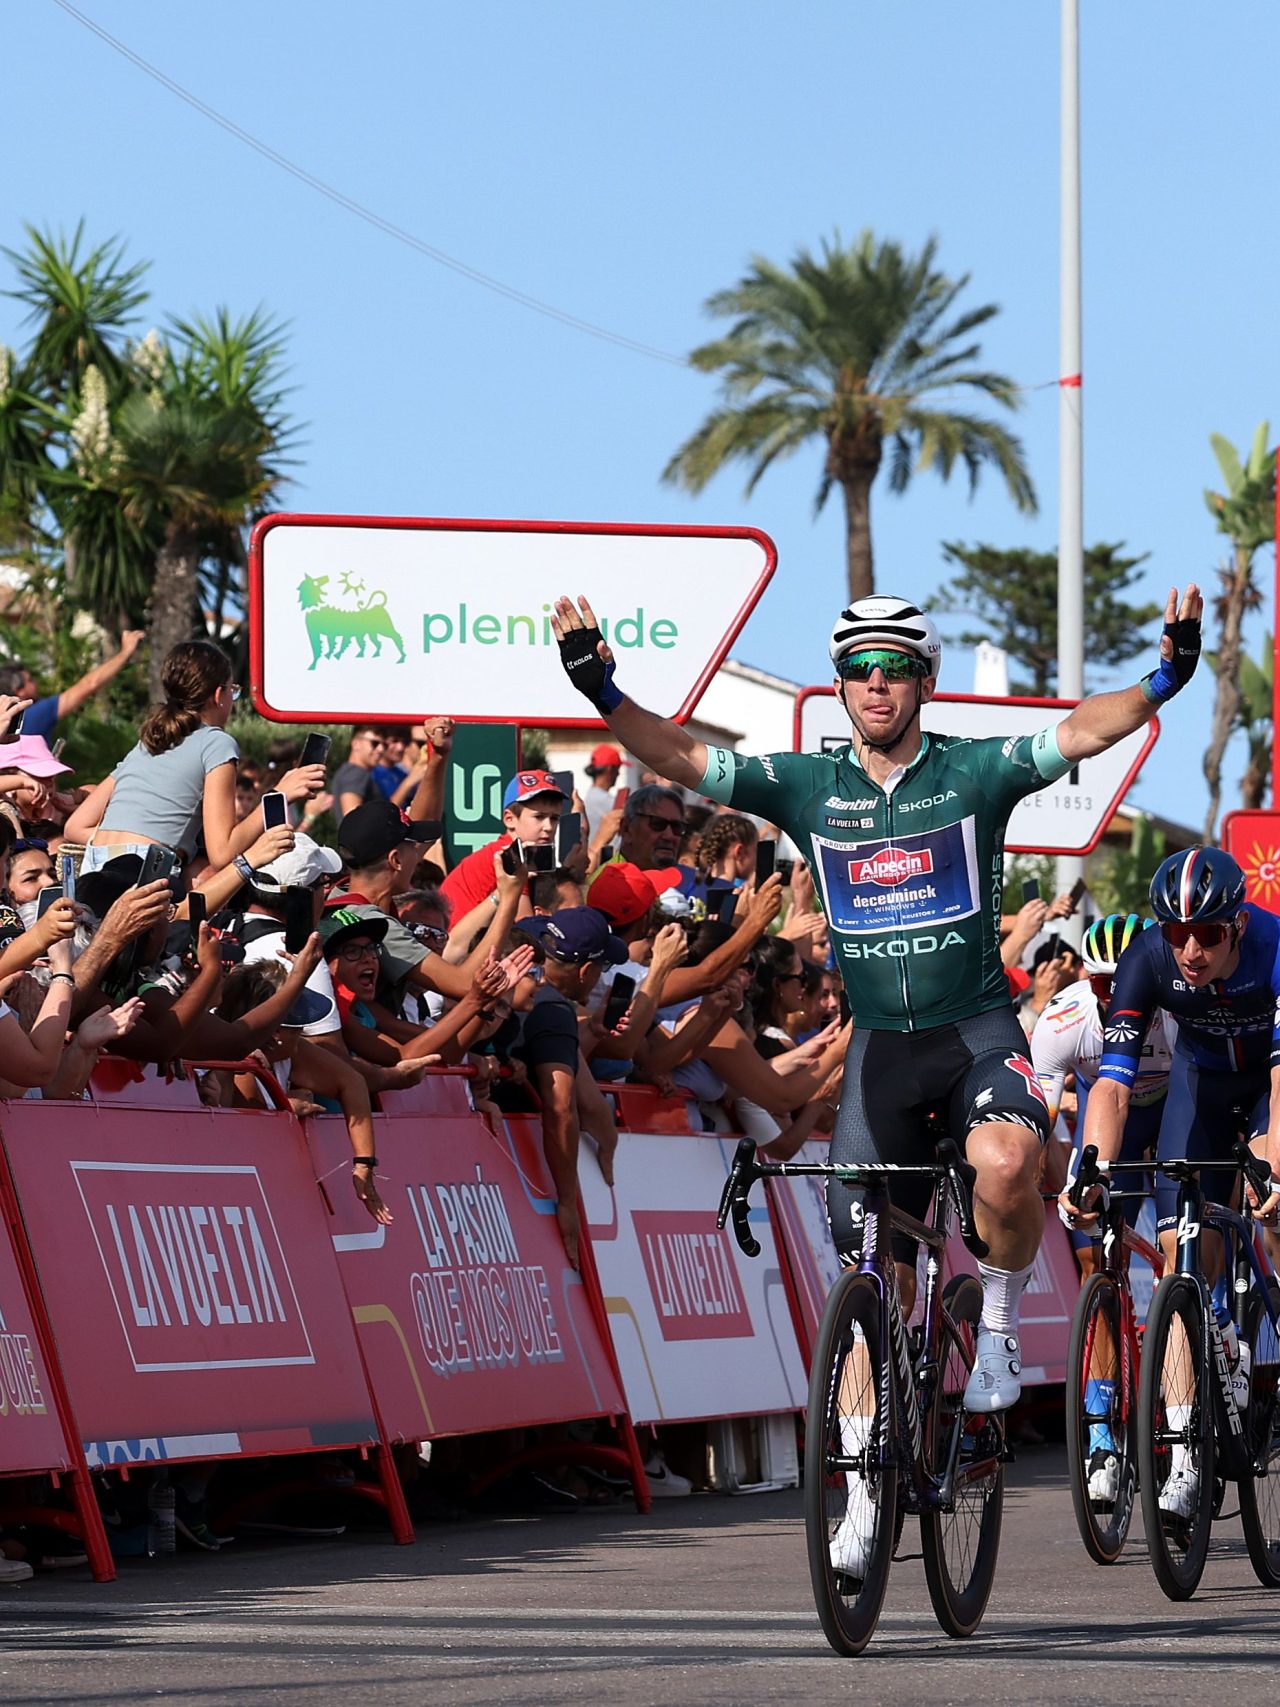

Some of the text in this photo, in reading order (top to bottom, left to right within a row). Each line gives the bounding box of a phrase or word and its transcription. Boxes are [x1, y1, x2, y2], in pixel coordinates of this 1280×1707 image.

[423, 603, 679, 653] plenide
[825, 796, 878, 811] Santini
[1055, 796, 1093, 810] 1853
[827, 818, 836, 826] LA
[836, 818, 860, 828] VUELTA
[824, 839, 855, 850] GROVES
[859, 856, 923, 879] Alpecin
[853, 885, 937, 908] deceuninck
[406, 1163, 521, 1269] LA PASIÓN
[105, 1204, 287, 1327] LA VUELTA
[646, 1232, 742, 1318] LA VUELTA
[409, 1270, 469, 1373] QUE
[504, 1265, 562, 1357] UNE
